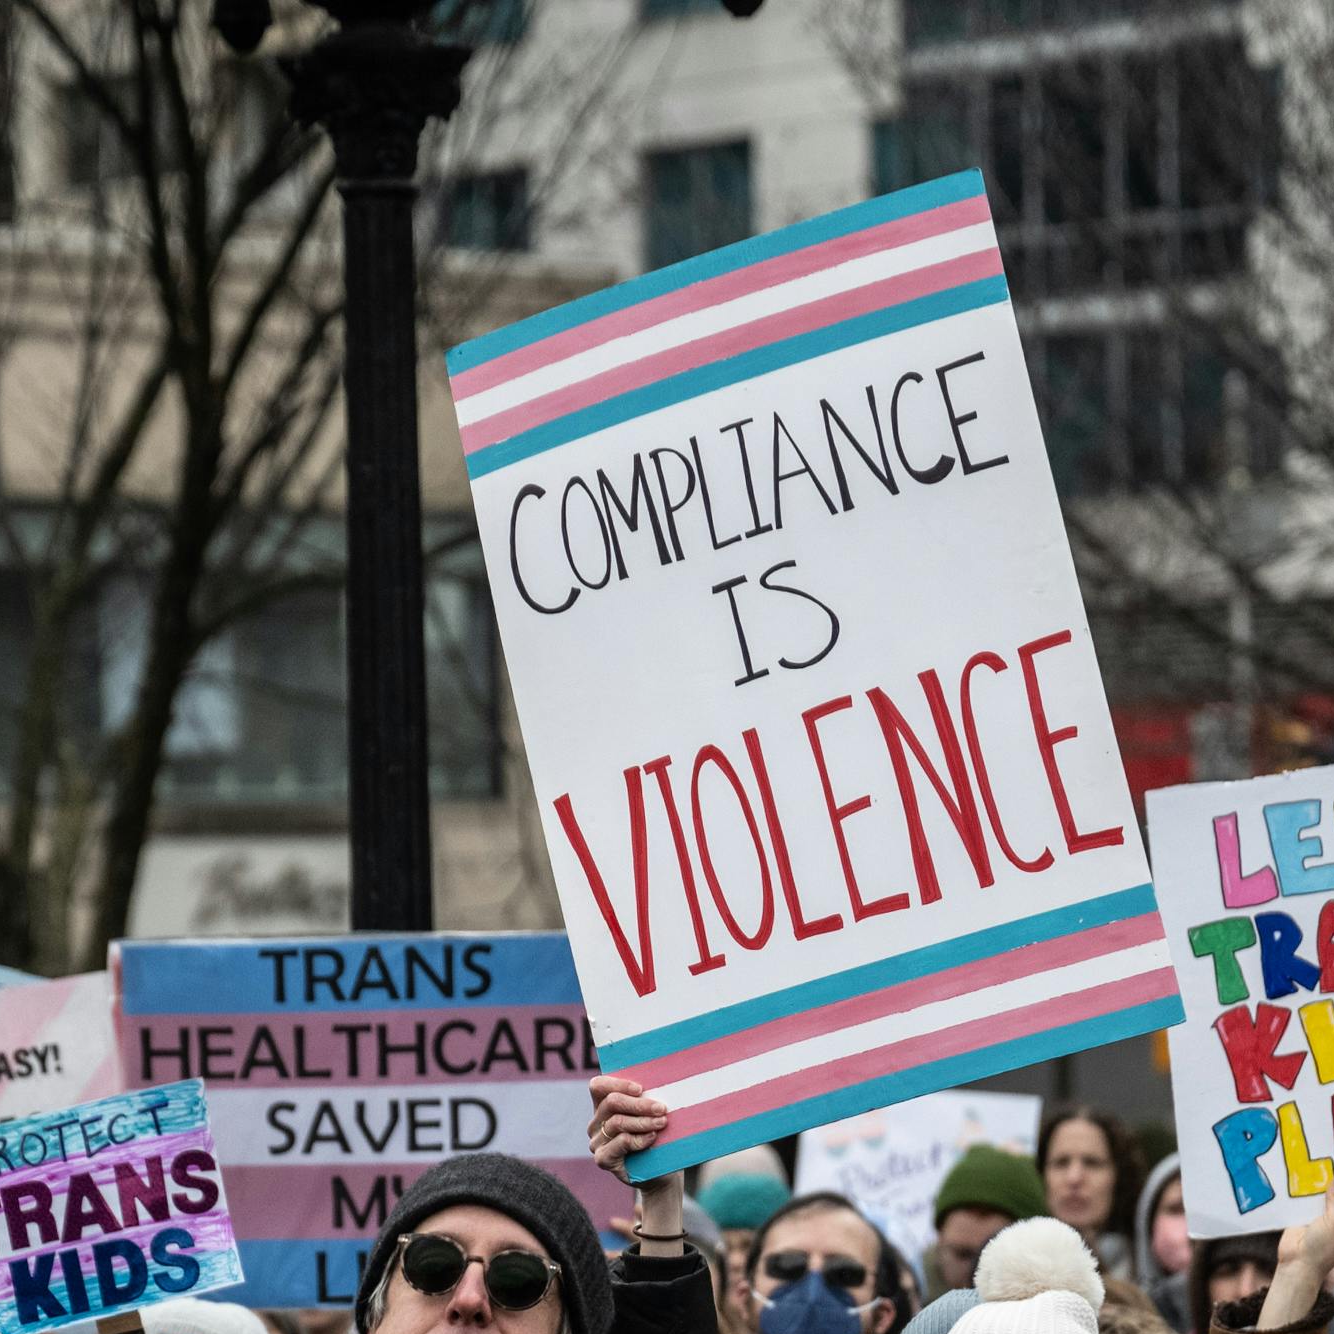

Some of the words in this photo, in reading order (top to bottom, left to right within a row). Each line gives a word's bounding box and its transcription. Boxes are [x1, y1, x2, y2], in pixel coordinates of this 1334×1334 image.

[509, 351, 1009, 615] COMPLIANCE
[710, 559, 841, 688] IS
[552, 629, 1124, 998] VIOLENCE
[258, 943, 492, 1004] TRANS
[266, 1096, 497, 1156] SAVED
[8, 1227, 201, 1326] KIDS
